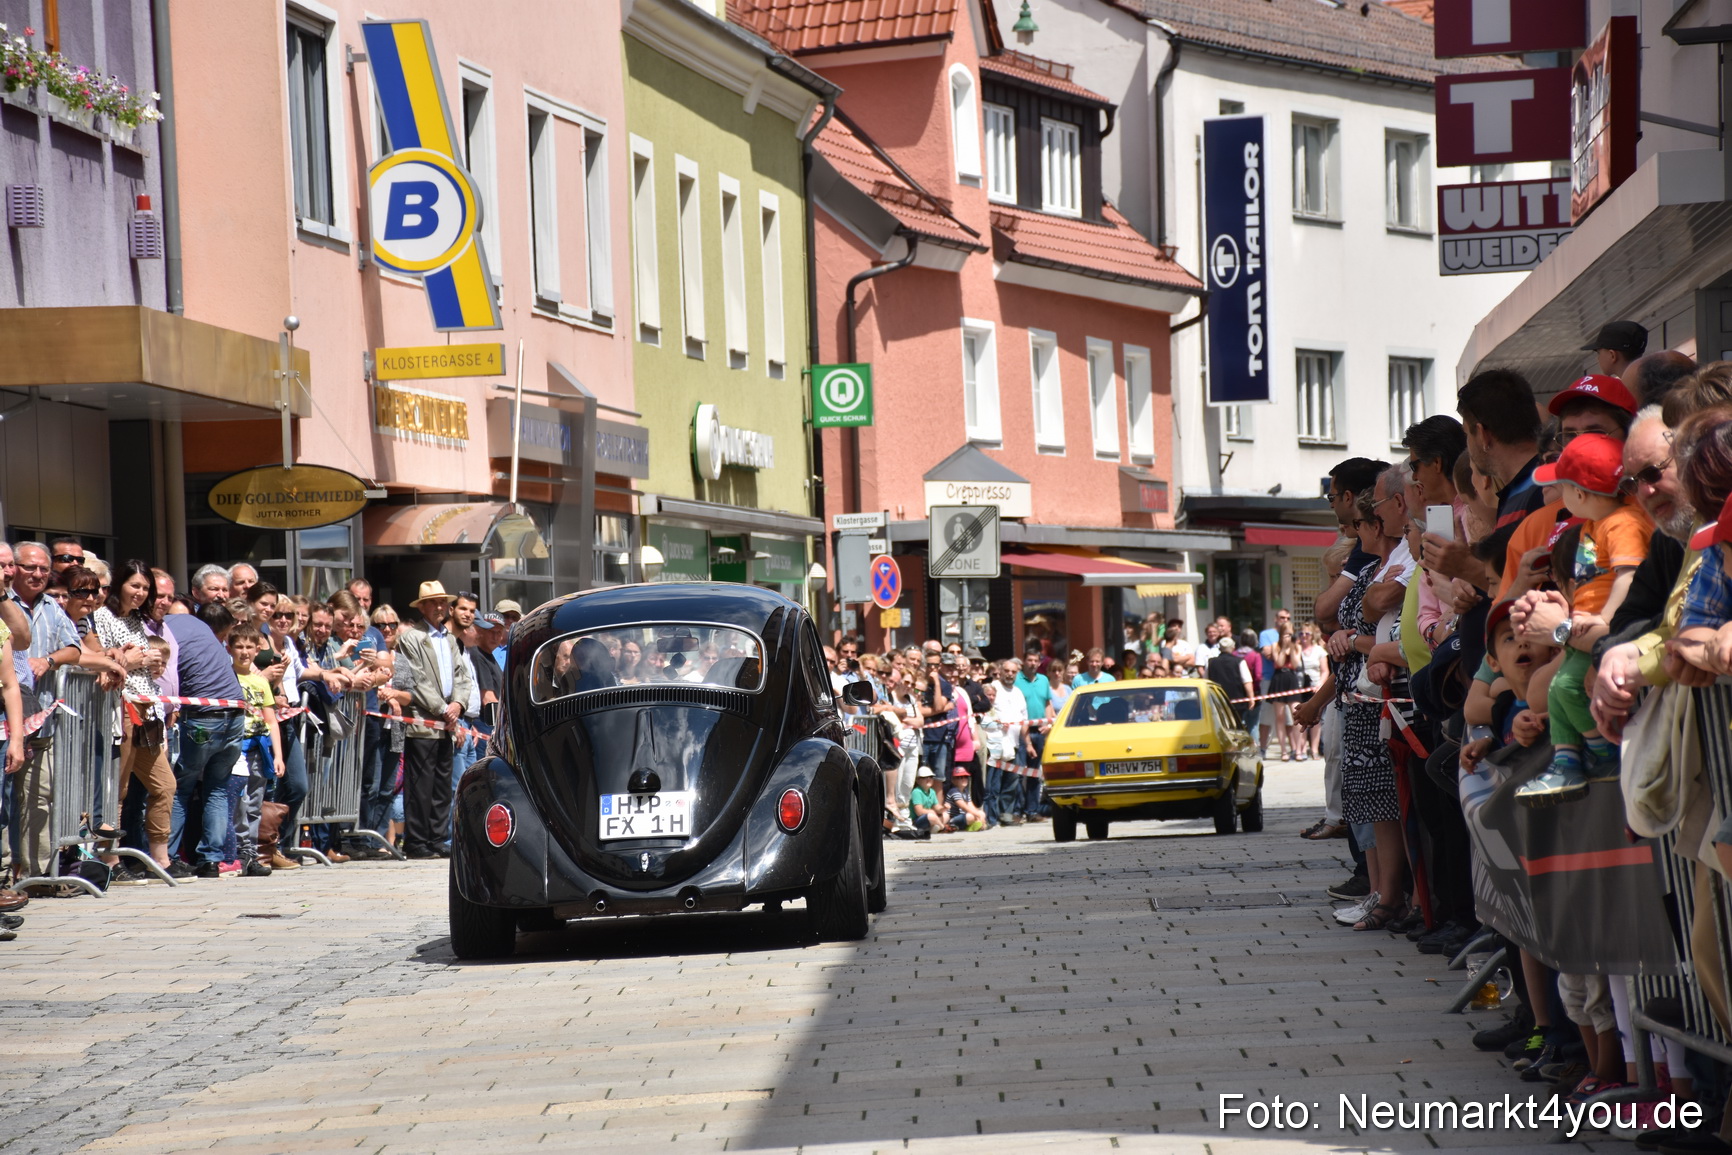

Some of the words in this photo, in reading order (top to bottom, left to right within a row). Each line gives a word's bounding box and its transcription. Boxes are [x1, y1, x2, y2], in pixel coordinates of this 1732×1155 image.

[384, 180, 439, 241] B
[1243, 141, 1261, 274] TAILOR
[1443, 181, 1571, 231] WITT
[1443, 231, 1573, 271] WEIDE
[1247, 281, 1263, 376] TOM
[383, 353, 482, 370] KLOSTERGASSE
[487, 353, 494, 365] 4
[819, 415, 841, 423] QUICK
[843, 414, 867, 422] SCHUH
[216, 493, 241, 506] DIE
[245, 489, 364, 505] GOLDSCHMIEDE
[946, 483, 1011, 505] Creppresso
[256, 510, 283, 518] JUTTA
[285, 509, 321, 518] ROTHER
[836, 516, 878, 526] Klostergasse
[947, 558, 981, 570] ZONE
[1106, 761, 1120, 774] RH
[1125, 761, 1140, 773] VW
[1141, 759, 1162, 772] 75H
[618, 795, 661, 815] HIP
[606, 816, 635, 836] FX
